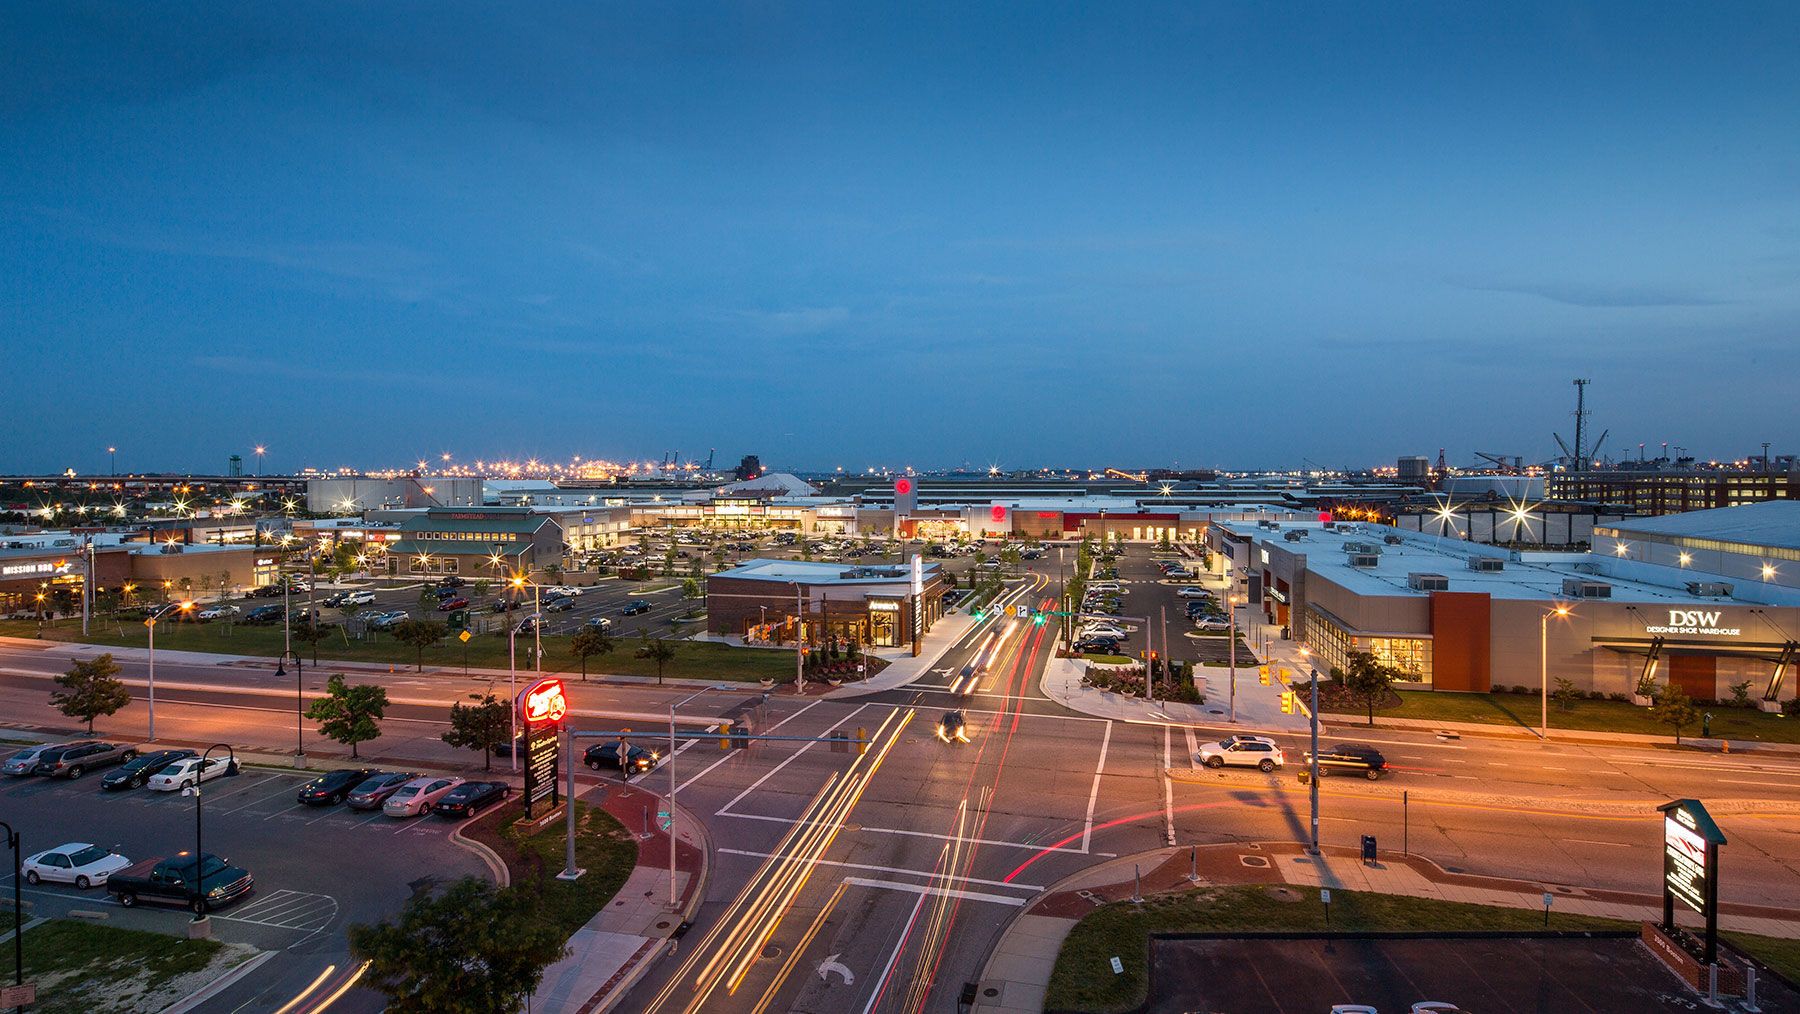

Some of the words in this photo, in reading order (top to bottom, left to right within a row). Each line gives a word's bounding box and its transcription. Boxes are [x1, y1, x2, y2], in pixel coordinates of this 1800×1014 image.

[3, 565, 36, 575] MISSION
[37, 563, 53, 572] BBQ
[1669, 610, 1721, 627] DSW
[1646, 626, 1679, 634] DESIGNER
[1679, 627, 1698, 635] SHOE
[1699, 628, 1741, 636] WAREHOUSE
